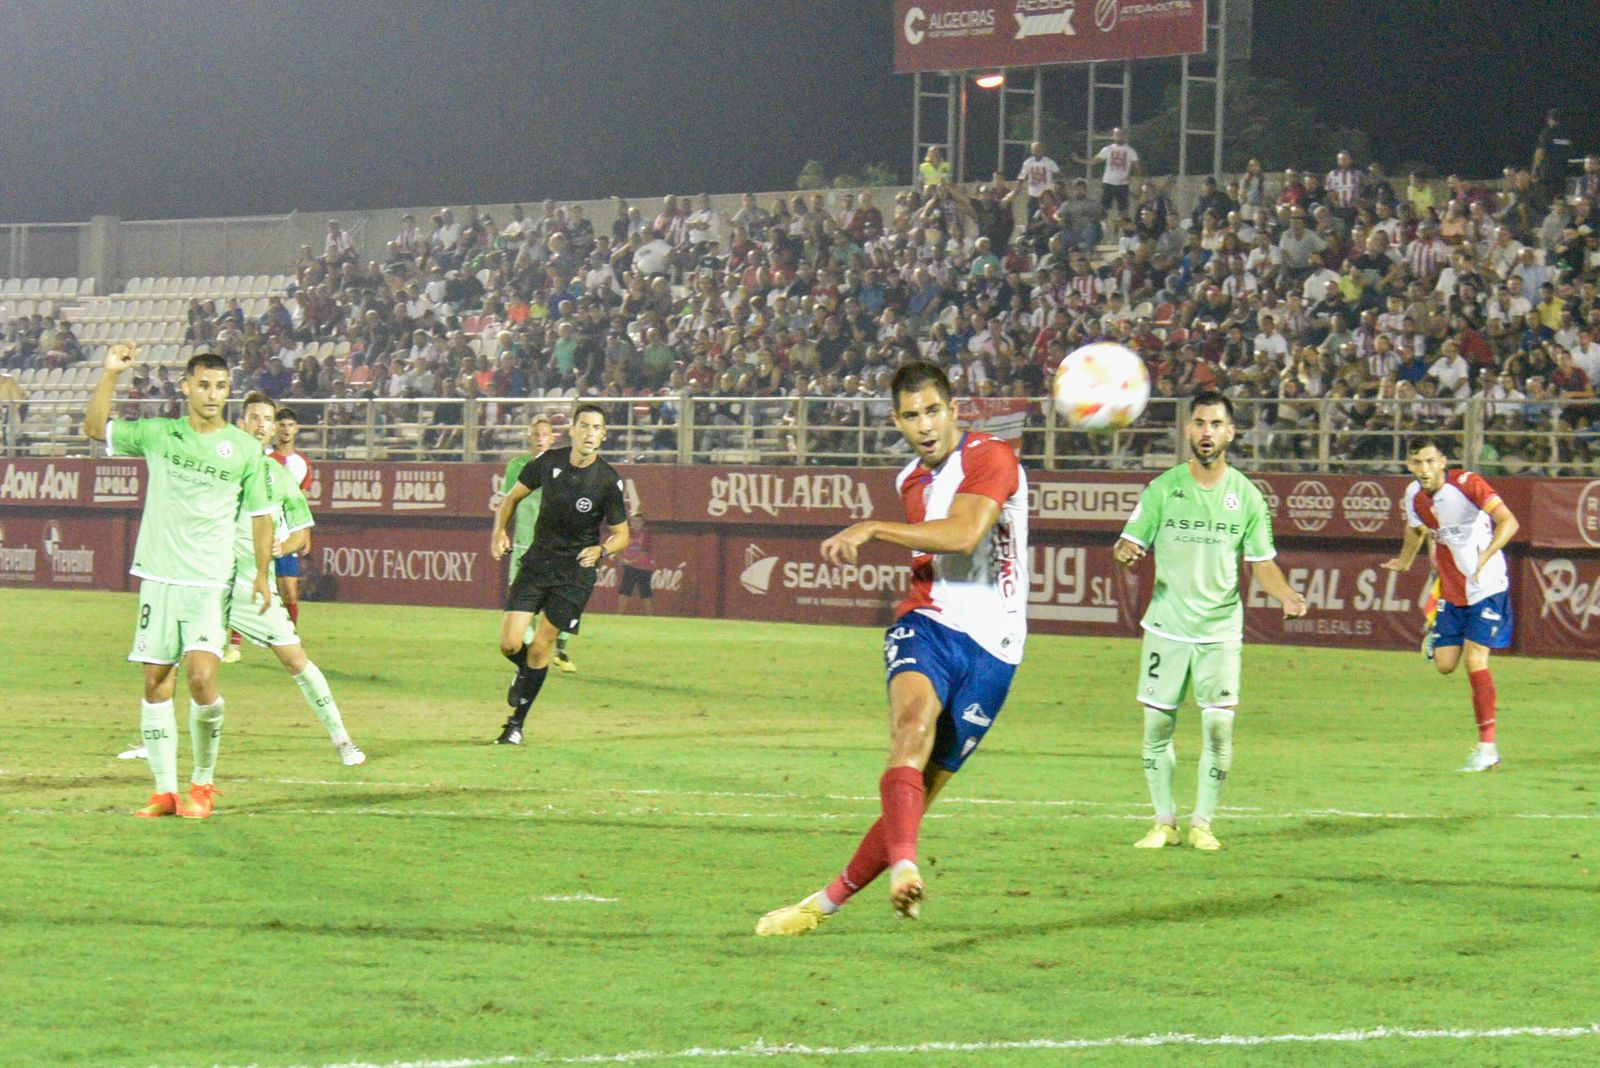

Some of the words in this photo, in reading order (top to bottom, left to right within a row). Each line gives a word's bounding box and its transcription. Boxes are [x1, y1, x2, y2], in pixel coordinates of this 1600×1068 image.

[930, 9, 995, 29] ALGECIRAS
[0, 463, 38, 499] AON
[39, 463, 79, 499] AON
[94, 476, 138, 494] APOLO
[332, 480, 382, 499] APOLO
[393, 482, 445, 501] APOLO
[1042, 490, 1138, 512] GRUAS
[1287, 496, 1334, 509] COSCO
[1342, 496, 1391, 510] COSCO
[1165, 519, 1240, 534] ASPIRE
[323, 547, 379, 578] BODY
[382, 550, 477, 582] FACTORY
[783, 561, 913, 592] SEA&PORT
[1353, 568, 1411, 612] S.L.
[140, 604, 151, 629] 8
[1148, 652, 1160, 679] 2
